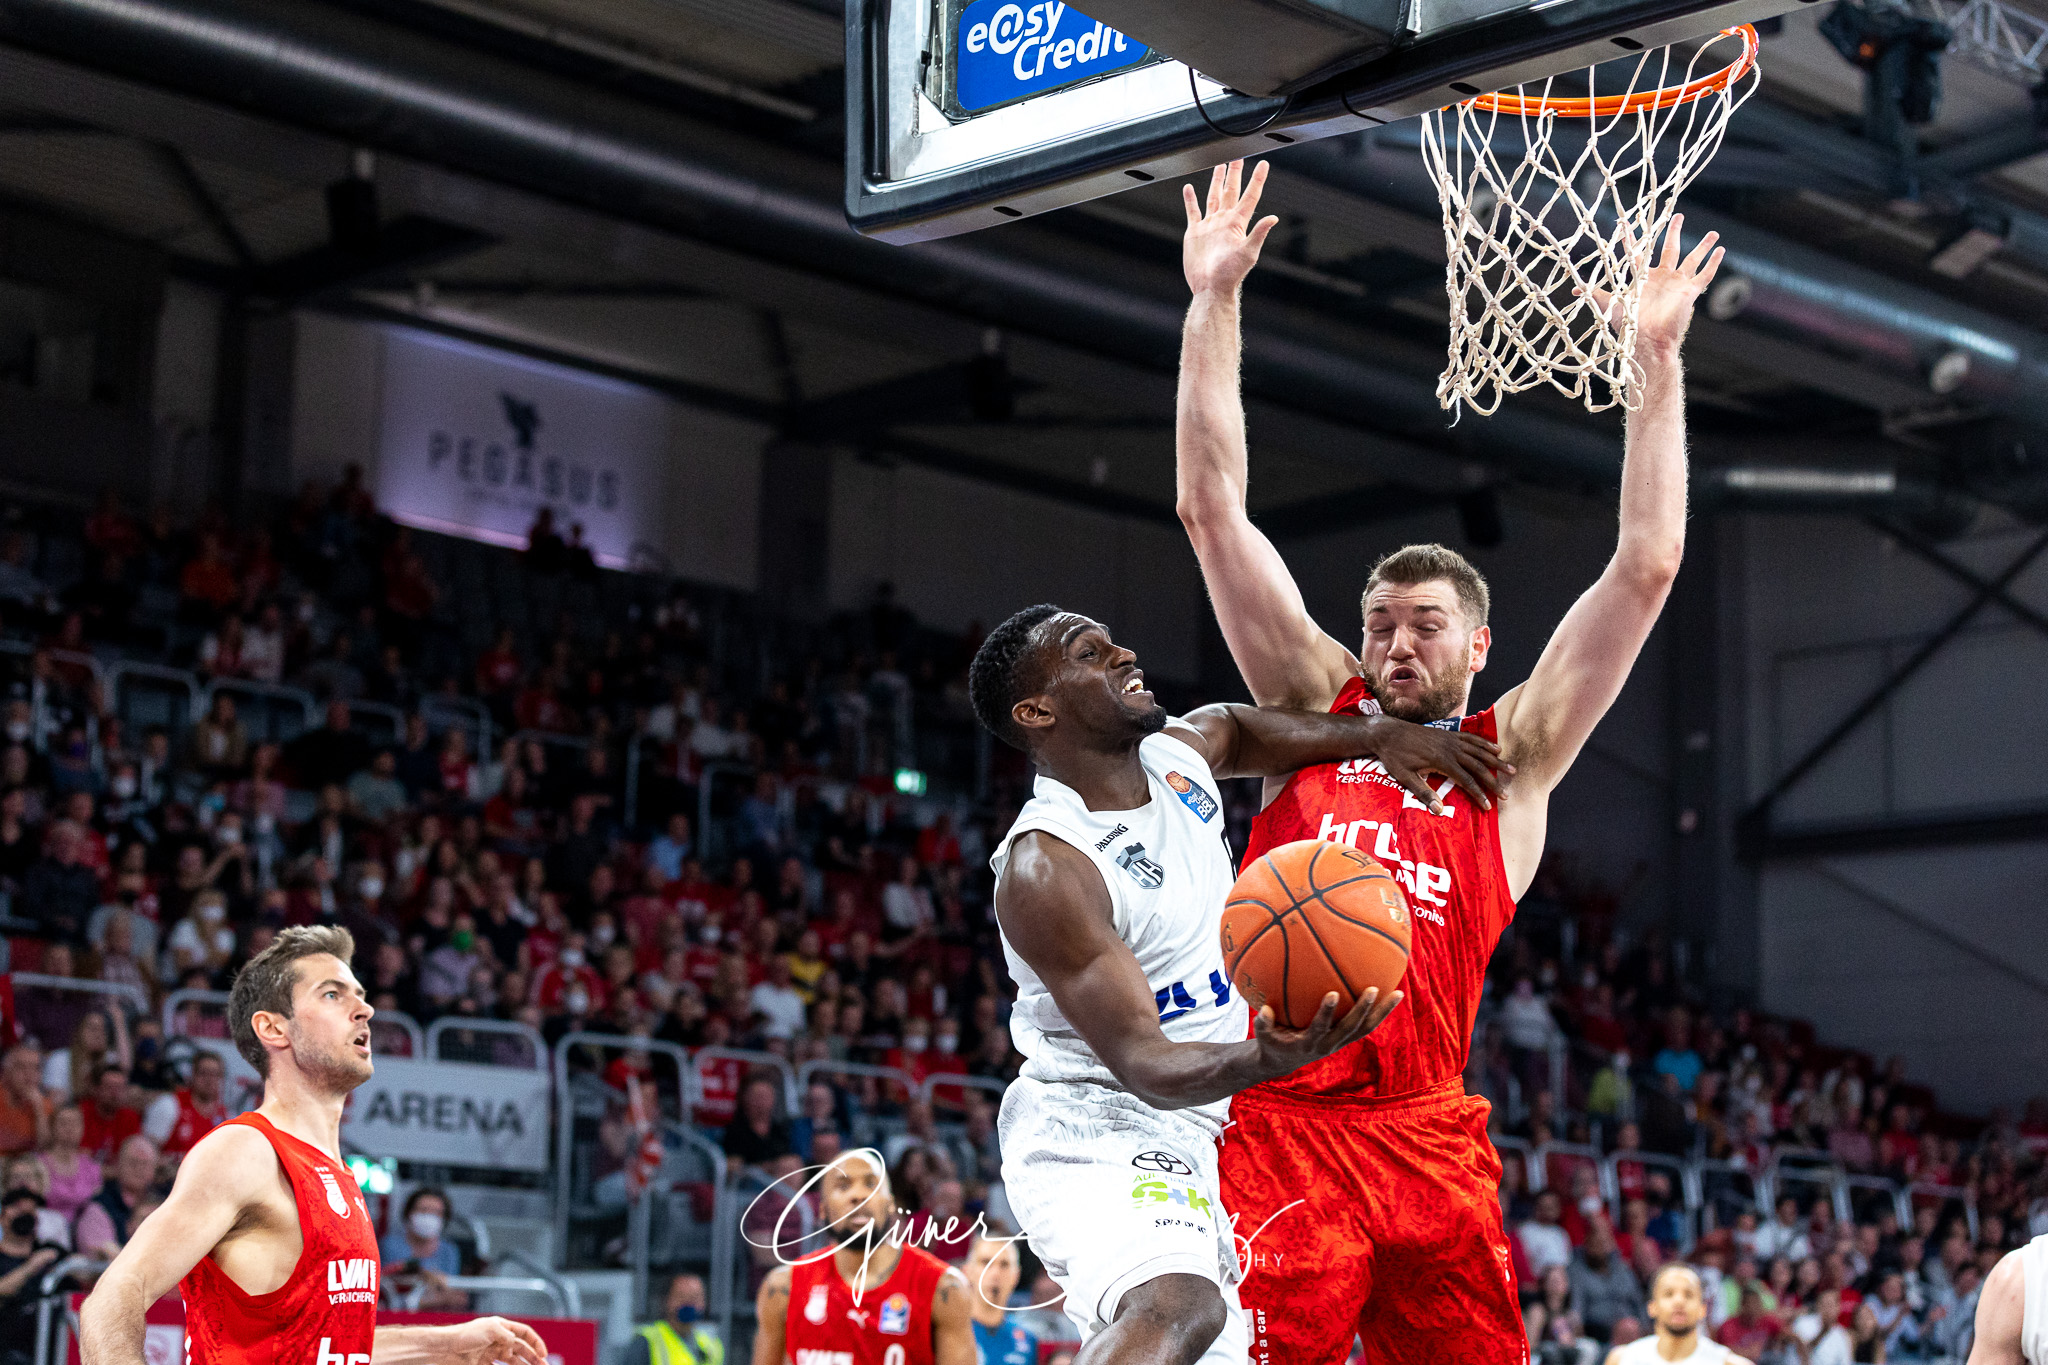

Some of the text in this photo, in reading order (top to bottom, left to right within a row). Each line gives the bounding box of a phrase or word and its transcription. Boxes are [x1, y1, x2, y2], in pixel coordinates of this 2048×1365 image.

[1013, 20, 1127, 81] Credit
[428, 430, 620, 511] PEGASUS
[1336, 773, 1405, 793] VERSICHERU
[1094, 823, 1129, 852] PALDING
[364, 1088, 524, 1137] ARENA
[327, 1259, 369, 1292] LVM
[1256, 1308, 1267, 1334] car
[1259, 1339, 1268, 1348] a
